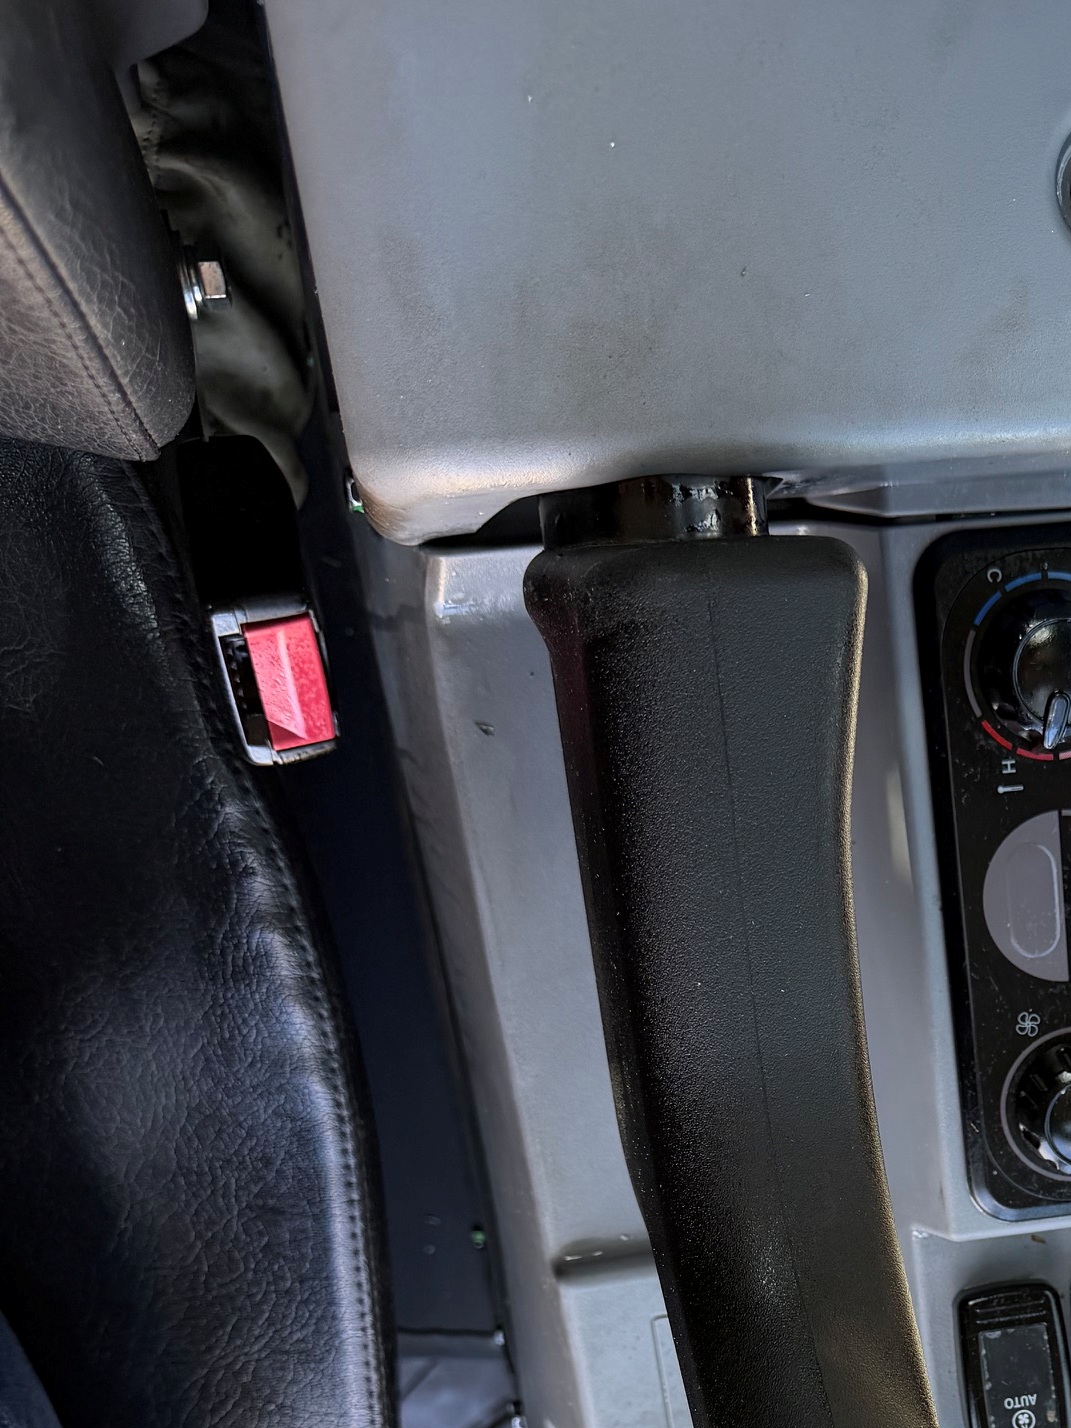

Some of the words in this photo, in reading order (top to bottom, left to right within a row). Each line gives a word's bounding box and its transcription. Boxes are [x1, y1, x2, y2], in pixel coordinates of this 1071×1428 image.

[987, 569, 1002, 583] C
[1002, 759, 1016, 774] H
[1004, 1393, 1037, 1409] AUTO
